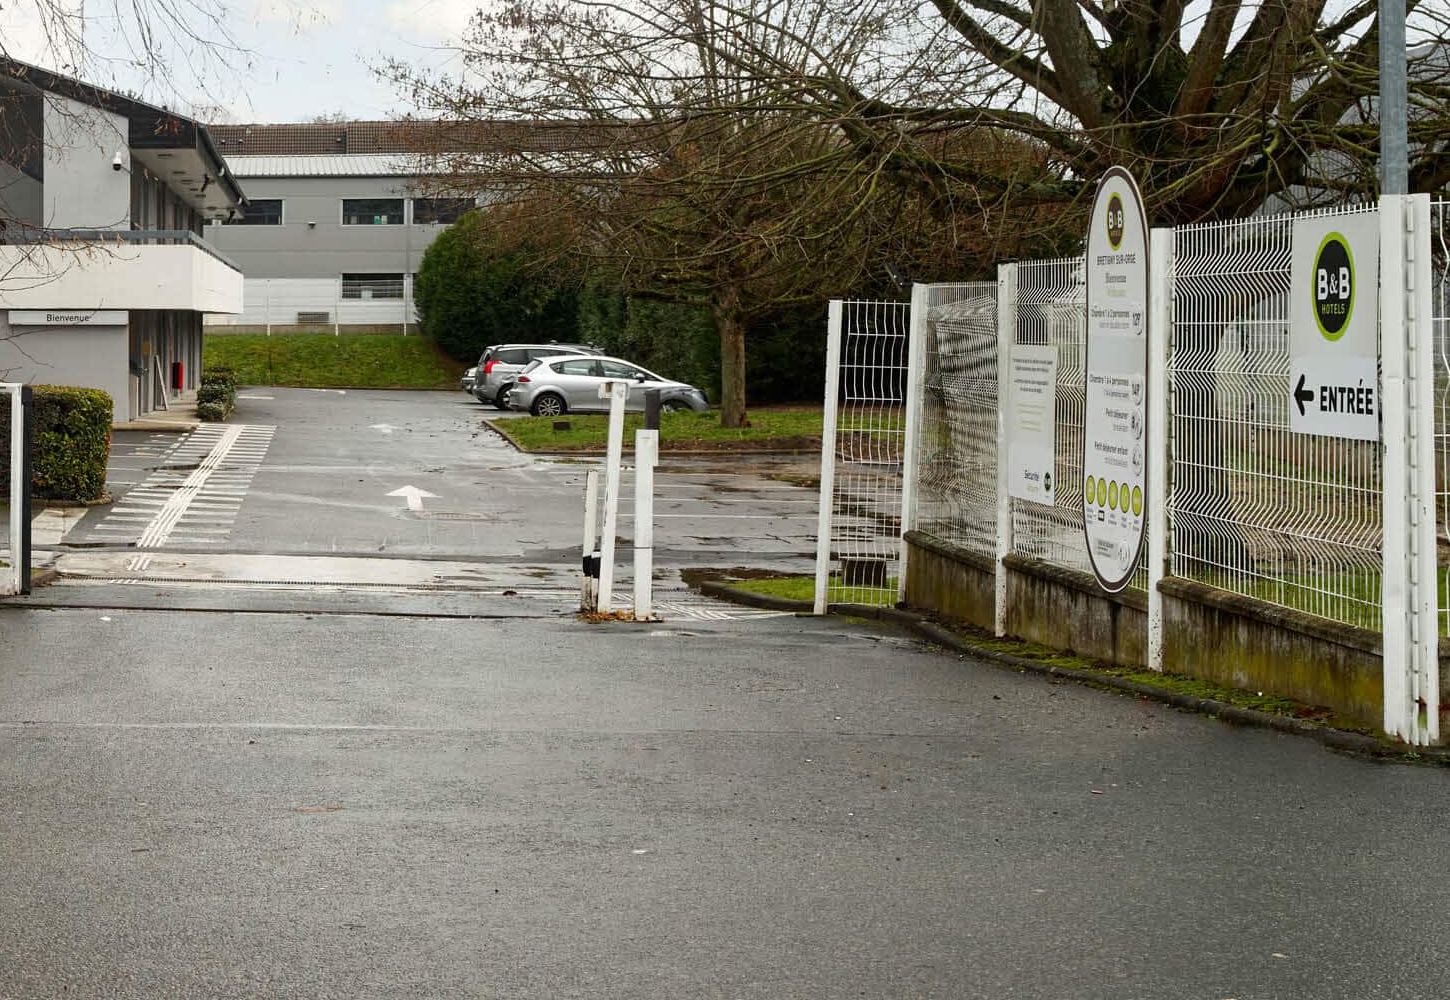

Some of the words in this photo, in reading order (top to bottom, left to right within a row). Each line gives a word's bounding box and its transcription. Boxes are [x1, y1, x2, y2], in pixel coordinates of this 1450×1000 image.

[1317, 266, 1351, 300] B&B
[46, 313, 90, 322] Bienvenue
[1321, 303, 1346, 315] HOTELS
[1319, 379, 1374, 416] ENTRÉE
